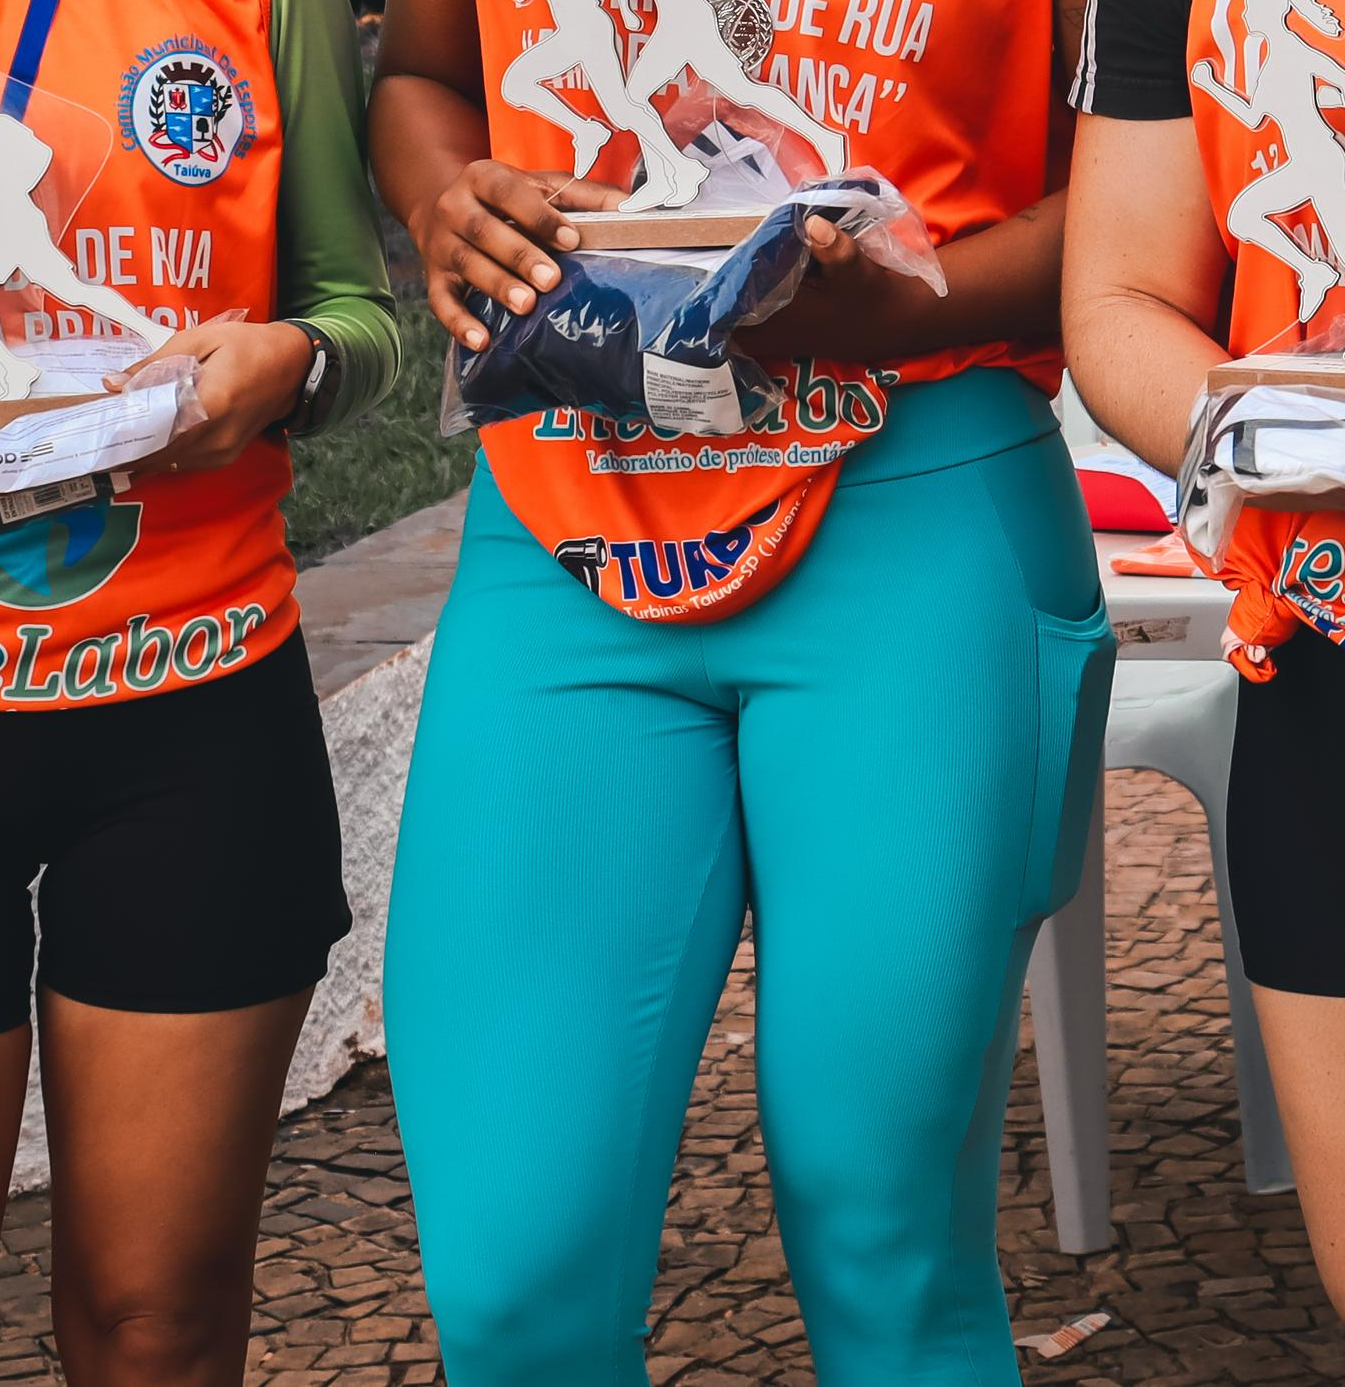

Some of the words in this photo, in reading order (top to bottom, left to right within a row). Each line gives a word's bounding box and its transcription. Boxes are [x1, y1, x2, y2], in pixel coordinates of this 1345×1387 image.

[173, 163, 212, 179] Taiúva
[75, 226, 138, 286] DE
[151, 226, 213, 289] RUA
[587, 447, 693, 475] Laboratório
[698, 444, 723, 470] de
[725, 443, 782, 474] prótese
[623, 603, 690, 621] Turbinas
[689, 554, 760, 611] Taiuva-SP
